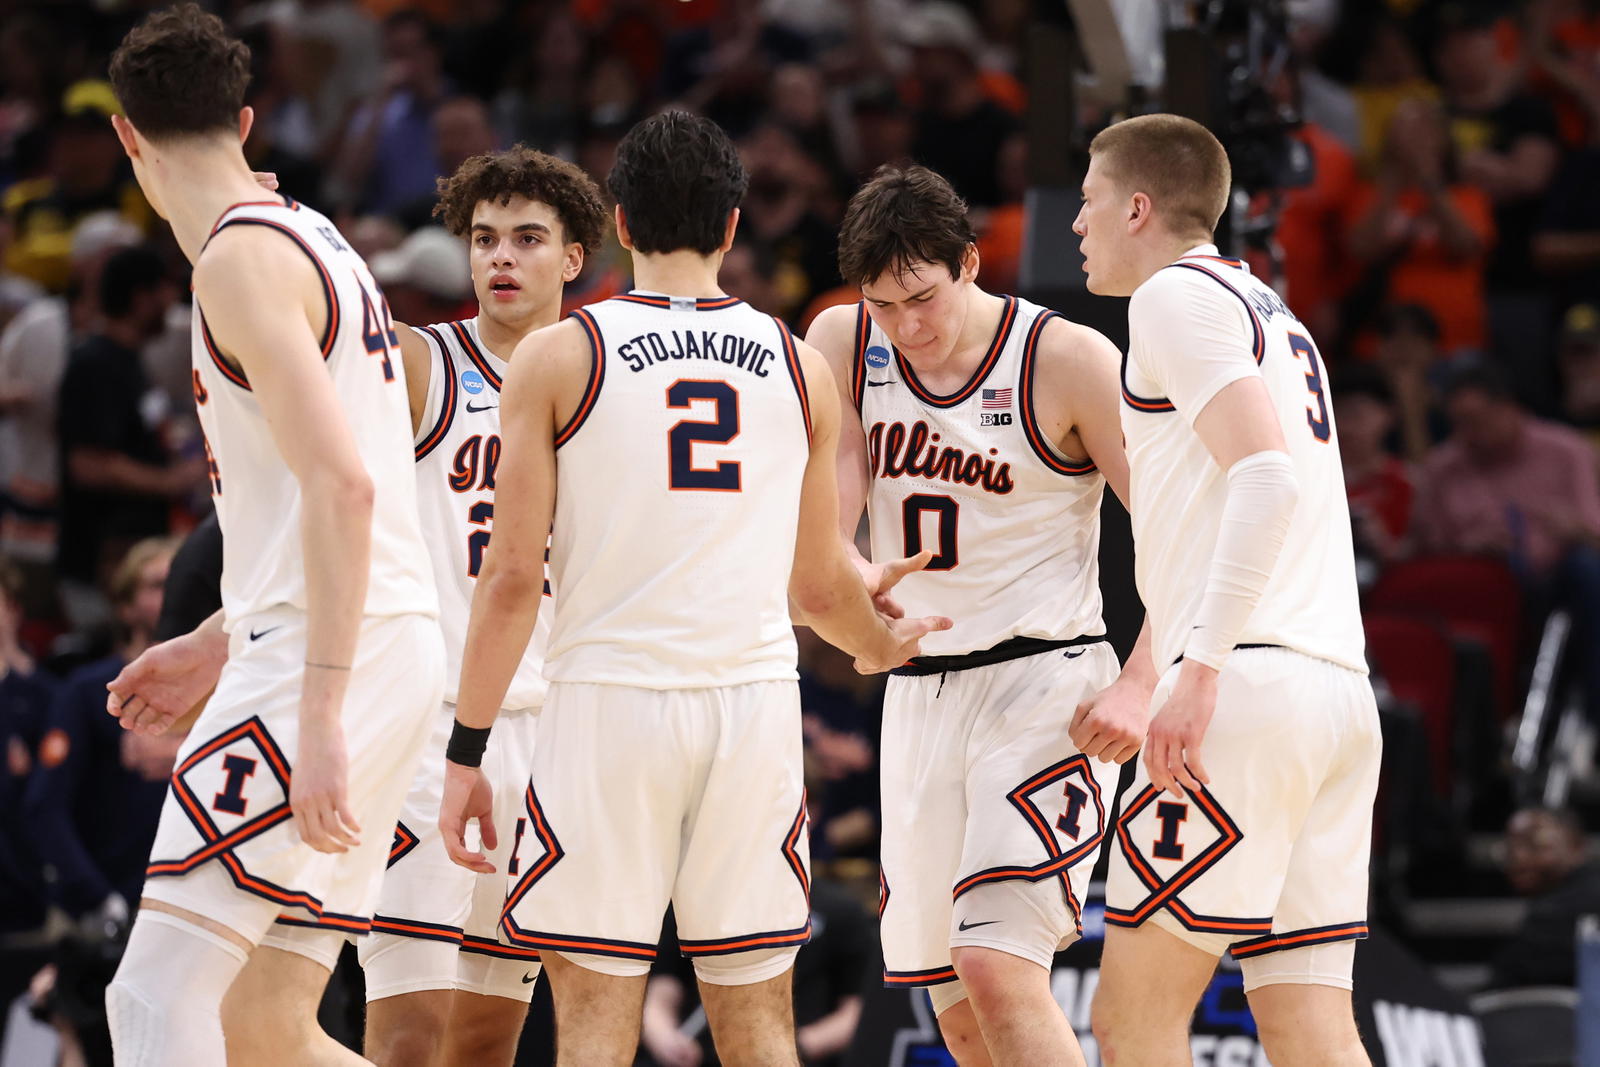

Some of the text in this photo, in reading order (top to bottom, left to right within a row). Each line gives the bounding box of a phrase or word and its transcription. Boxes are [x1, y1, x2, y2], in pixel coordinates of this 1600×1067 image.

[617, 330, 776, 378] STOJAKOVIC
[867, 355, 888, 365] NCAA
[1287, 330, 1331, 444] 3
[665, 378, 742, 492] 2
[869, 420, 1014, 495] Illinois
[902, 493, 960, 571] 0
[213, 754, 258, 817] I
[1055, 781, 1088, 841] I
[1152, 800, 1188, 861] I
